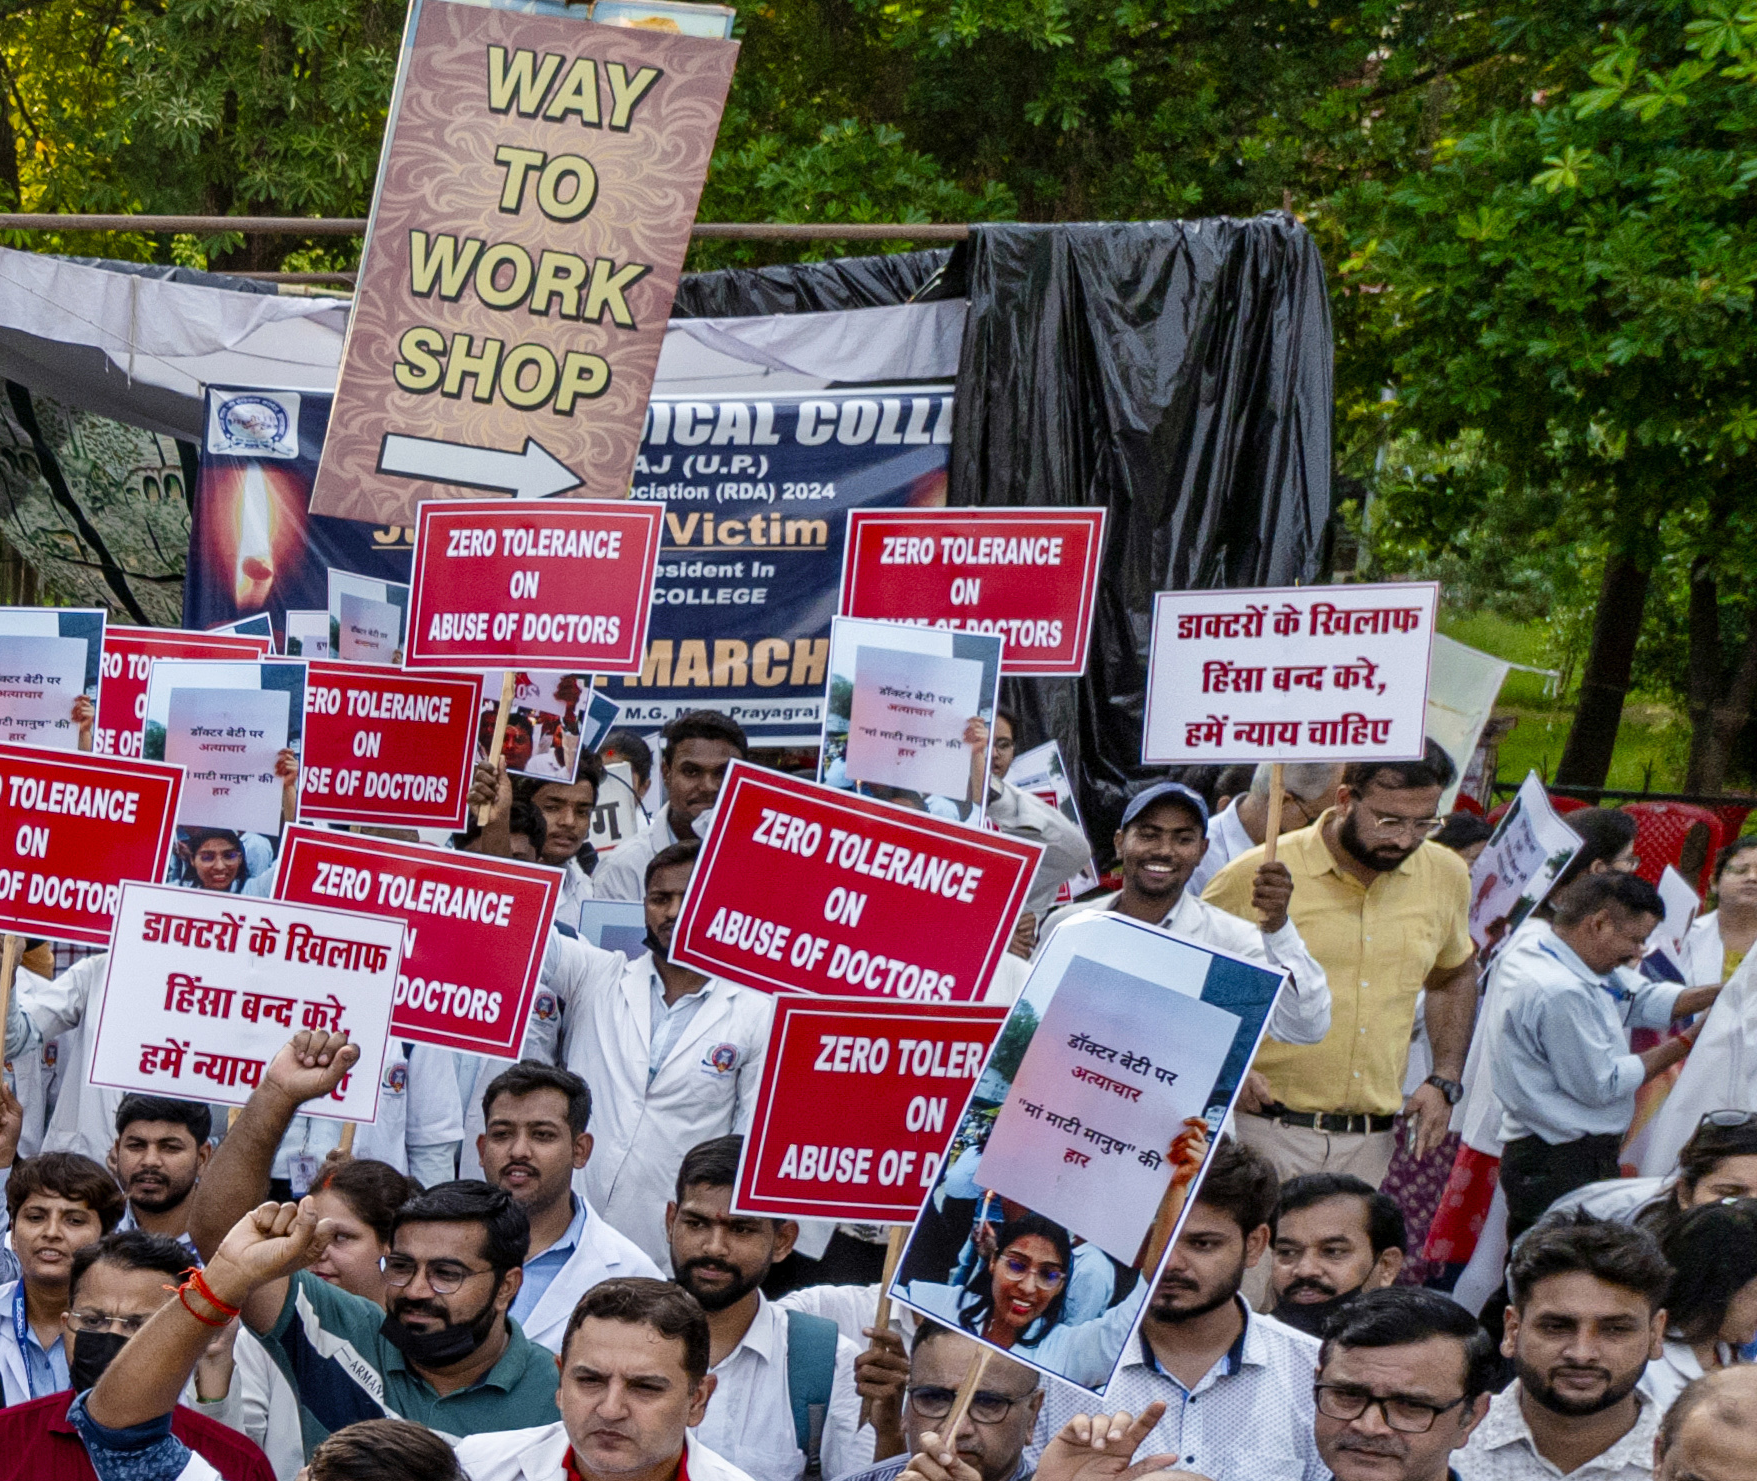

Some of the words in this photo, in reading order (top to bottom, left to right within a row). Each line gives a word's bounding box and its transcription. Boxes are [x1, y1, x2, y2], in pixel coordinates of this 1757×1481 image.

[487, 44, 662, 132] WAY
[494, 144, 599, 223] TO
[408, 229, 653, 329] WORK
[392, 326, 612, 415] SHOP
[447, 529, 496, 556] ZERO
[503, 529, 622, 559] TOLERANCE
[666, 513, 828, 545] Victim
[510, 571, 539, 598] ON
[429, 613, 489, 640] ABUSE
[493, 613, 519, 640] OF
[522, 614, 620, 644] DOCTORS
[1178, 605, 1268, 639] डाक्टरों
[1274, 604, 1302, 636] के
[1310, 603, 1422, 635] खिलाफ
[1203, 661, 1266, 692] हिंसा
[1273, 666, 1327, 691] बन्द
[1333, 657, 1385, 695] करे,
[1186, 715, 1229, 747] हमें
[1234, 722, 1302, 746] न्याय
[1308, 713, 1392, 745] चाहिए
